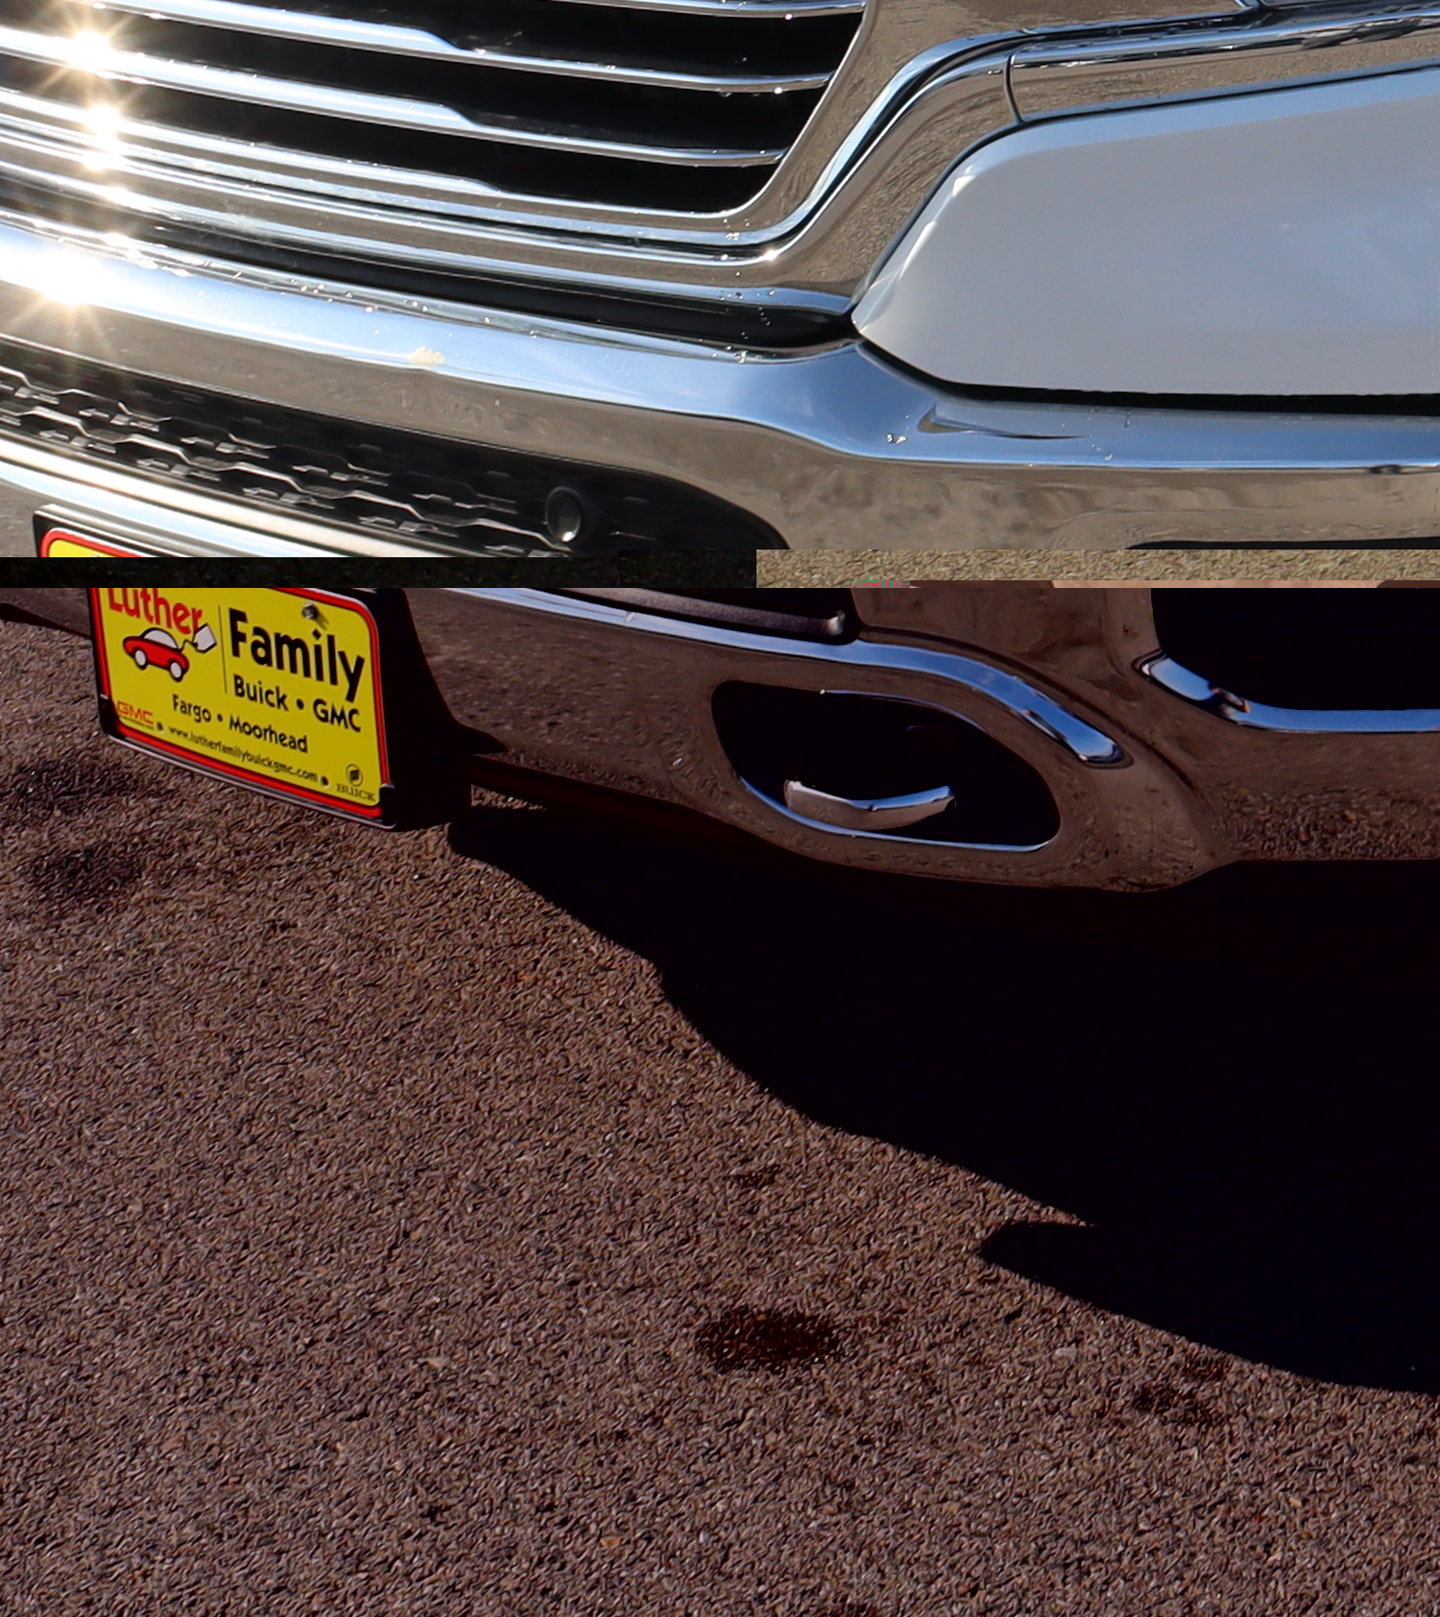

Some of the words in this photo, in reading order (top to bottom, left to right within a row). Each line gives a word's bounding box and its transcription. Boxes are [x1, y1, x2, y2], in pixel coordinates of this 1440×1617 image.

[109, 588, 203, 634] Luther
[228, 607, 365, 703] Family
[116, 701, 155, 725] GMC
[172, 694, 212, 723] Fargo
[228, 714, 309, 753] Moorhead
[233, 674, 289, 712] Buick
[313, 698, 362, 732] GMC
[169, 725, 318, 782] www.lutherfamilybuickgmc.com
[336, 783, 377, 802] BUICK
